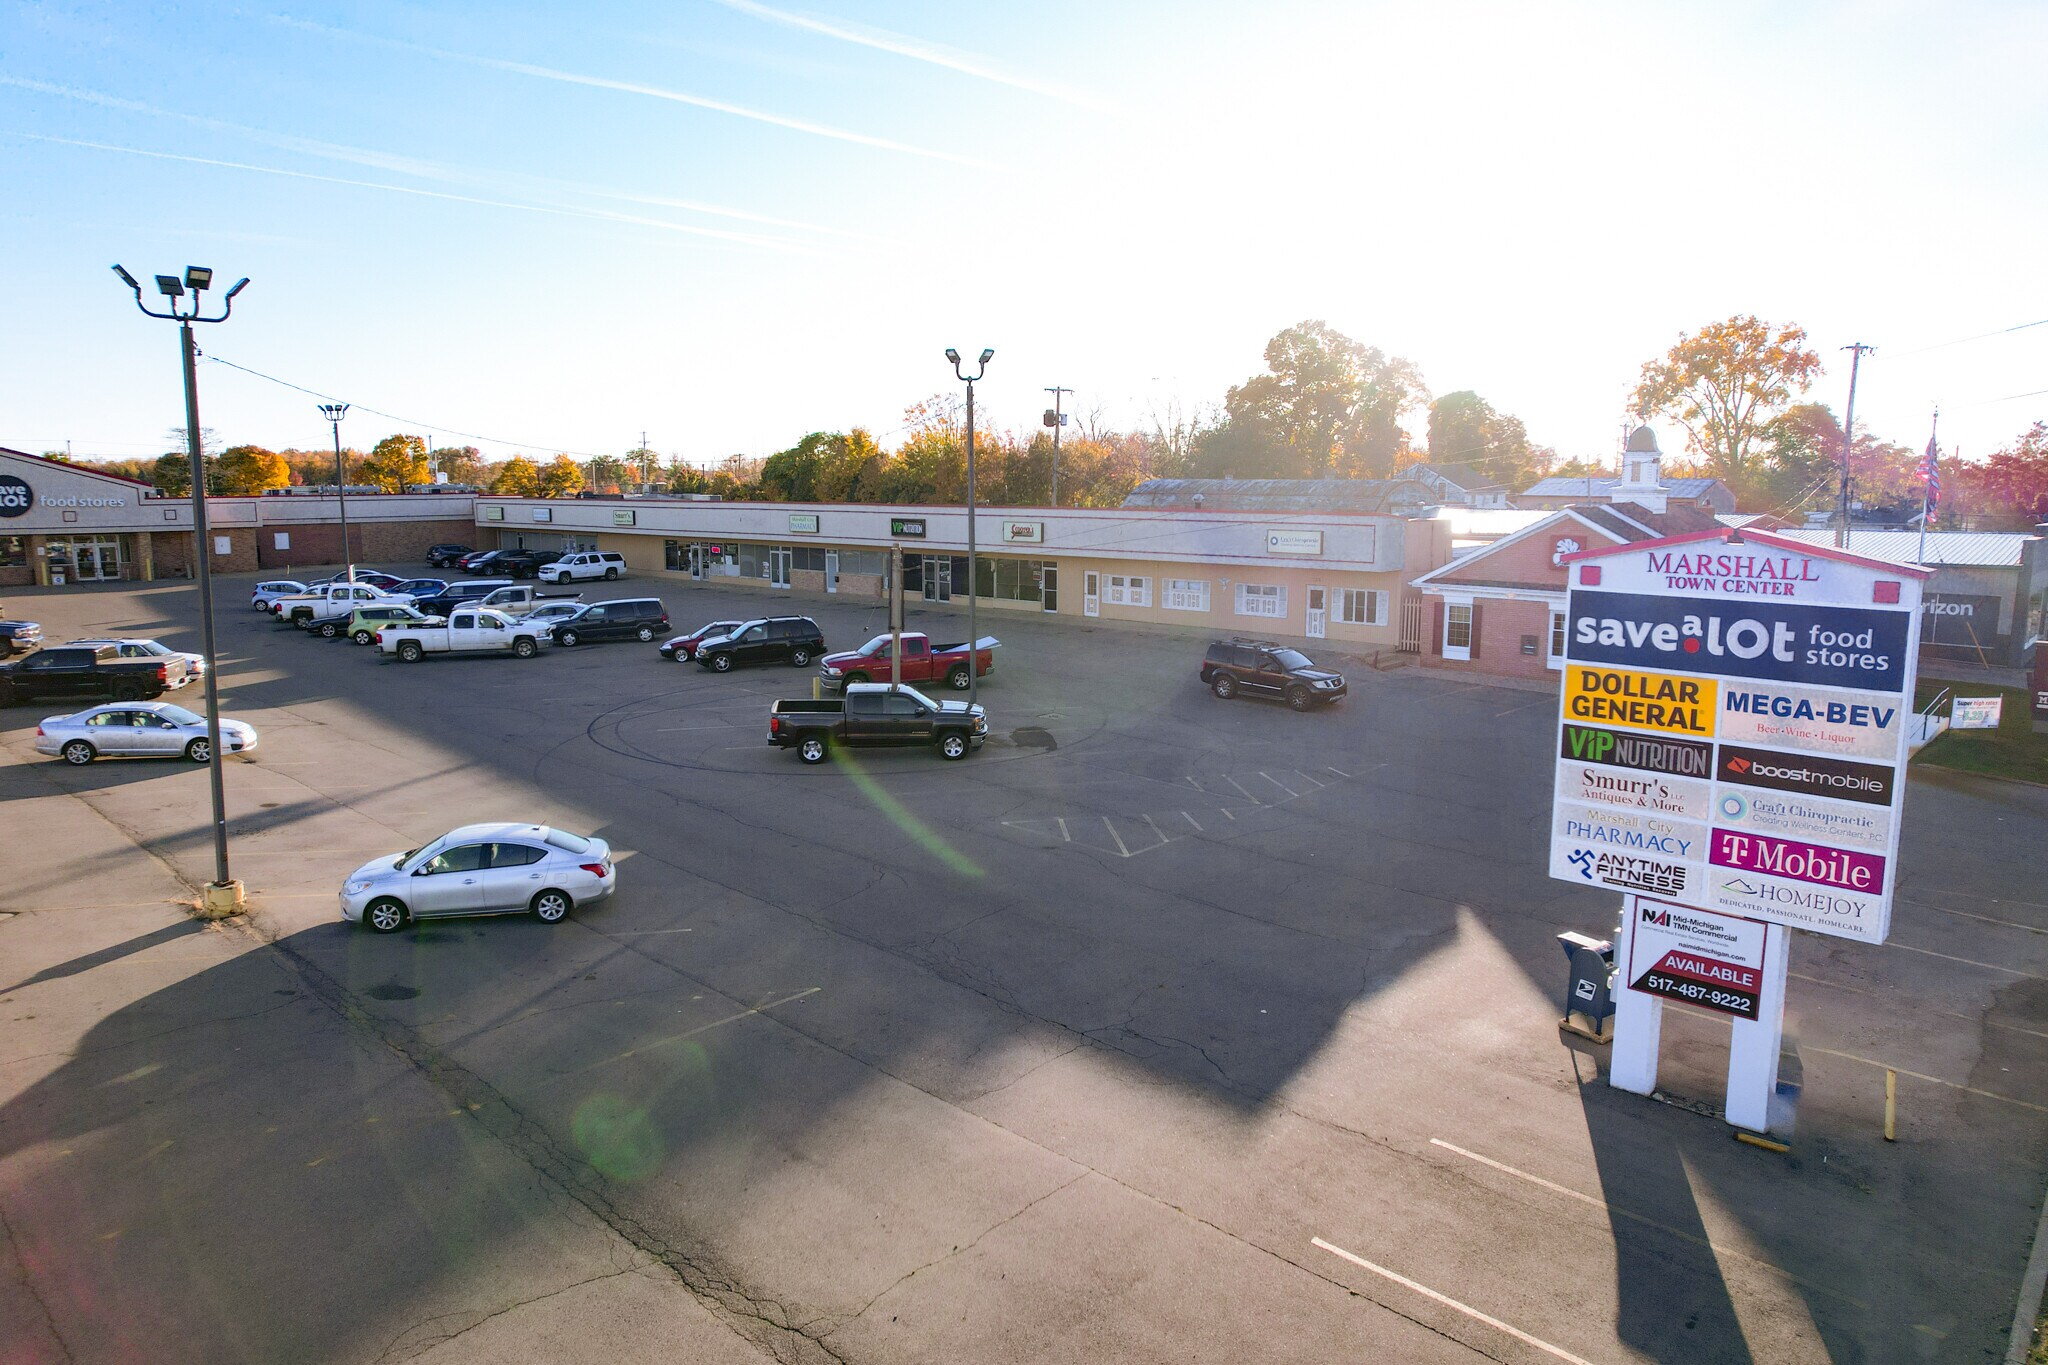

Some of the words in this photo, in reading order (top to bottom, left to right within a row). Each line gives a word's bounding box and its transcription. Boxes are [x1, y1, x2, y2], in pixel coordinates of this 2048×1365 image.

[0, 486, 26, 495] ave
[39, 496, 76, 507] food
[78, 497, 125, 507] stores
[1647, 552, 1820, 582] MARSHALL
[1666, 576, 1716, 592] TOWN
[1722, 579, 1795, 596] CENTER
[1922, 599, 1974, 617] rizon
[1576, 616, 1678, 652] save
[1809, 625, 1873, 649] food
[1806, 648, 1889, 671] stores
[1581, 670, 1699, 705] DOLLAR
[1571, 694, 1706, 732] GENERAL
[1726, 691, 1895, 729] MEGA-BEV
[1757, 723, 1780, 734] Beer
[1785, 726, 1811, 738] Wine
[1820, 730, 1856, 744] Liquor
[1616, 739, 1707, 775] NUTRITION
[1582, 768, 1669, 799] Smurr's
[1581, 789, 1632, 807] Antiques
[1637, 797, 1647, 807] &
[1652, 798, 1685, 813] More
[1752, 799, 1787, 816] Craft
[1789, 804, 1874, 828] Chiropractic
[1587, 809, 1639, 828] Marshall
[1648, 820, 1674, 835] City
[1752, 815, 1789, 828] Creating
[1791, 820, 1827, 834] Wellness
[1566, 820, 1692, 856] PHARMACY
[1596, 864, 1685, 890] FITNESS
[1598, 853, 1686, 878] ANYTIME
[1755, 840, 1871, 889] Mobile
[1760, 883, 1867, 918] HOMEJOY
[1642, 908, 1671, 927] NAI
[1673, 915, 1724, 932] Mid-Michigan
[1673, 922, 1691, 932] TMN
[1691, 926, 1738, 943] Commercial
[1678, 941, 1746, 962] naimidmichigan.com
[1665, 955, 1754, 987] AVAILABLE
[1648, 975, 1751, 1012] 517-487-9222
